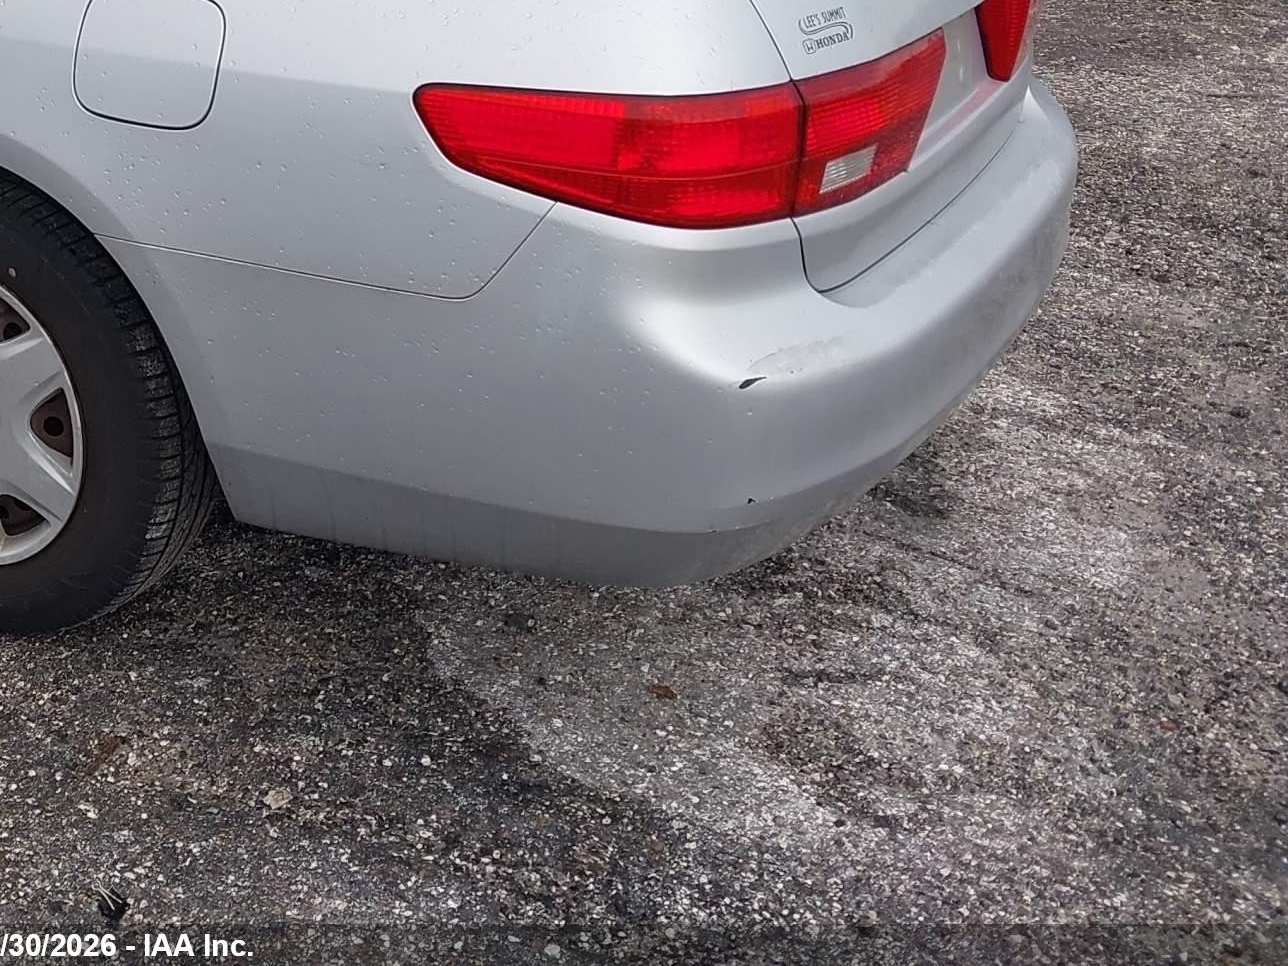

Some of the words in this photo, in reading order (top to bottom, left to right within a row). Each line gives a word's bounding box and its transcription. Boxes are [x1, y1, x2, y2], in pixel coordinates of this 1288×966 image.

[803, 14, 821, 29] LEE'S
[821, 7, 846, 23] SUMMIT
[815, 32, 850, 50] HONDA
